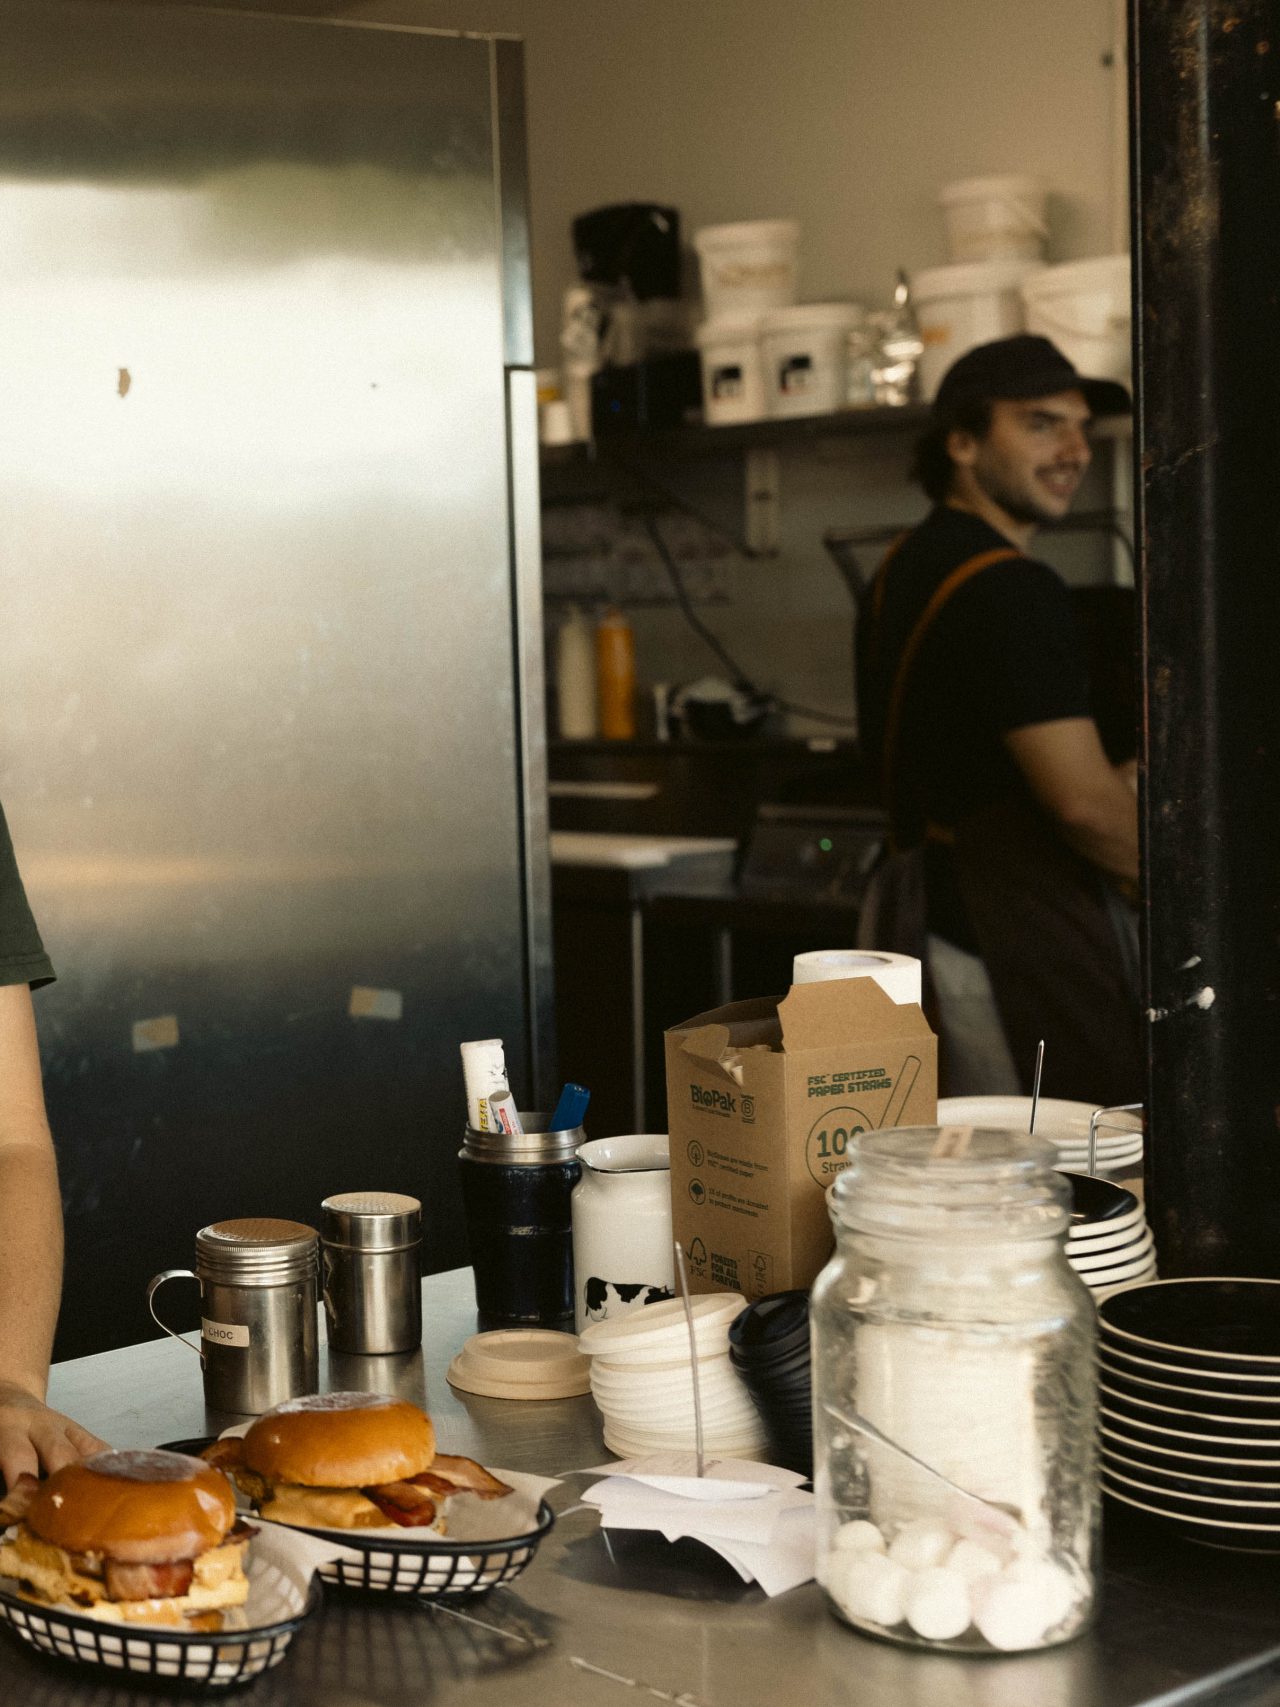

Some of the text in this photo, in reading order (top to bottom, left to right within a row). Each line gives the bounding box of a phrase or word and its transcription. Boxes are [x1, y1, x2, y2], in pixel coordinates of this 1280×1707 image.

[832, 1068, 886, 1082] CERTIFIED
[807, 1078, 892, 1097] PAPER STRAWS
[690, 1085, 736, 1113] BioPak
[816, 1125, 865, 1158] 10
[208, 1327, 233, 1340] CHOC
